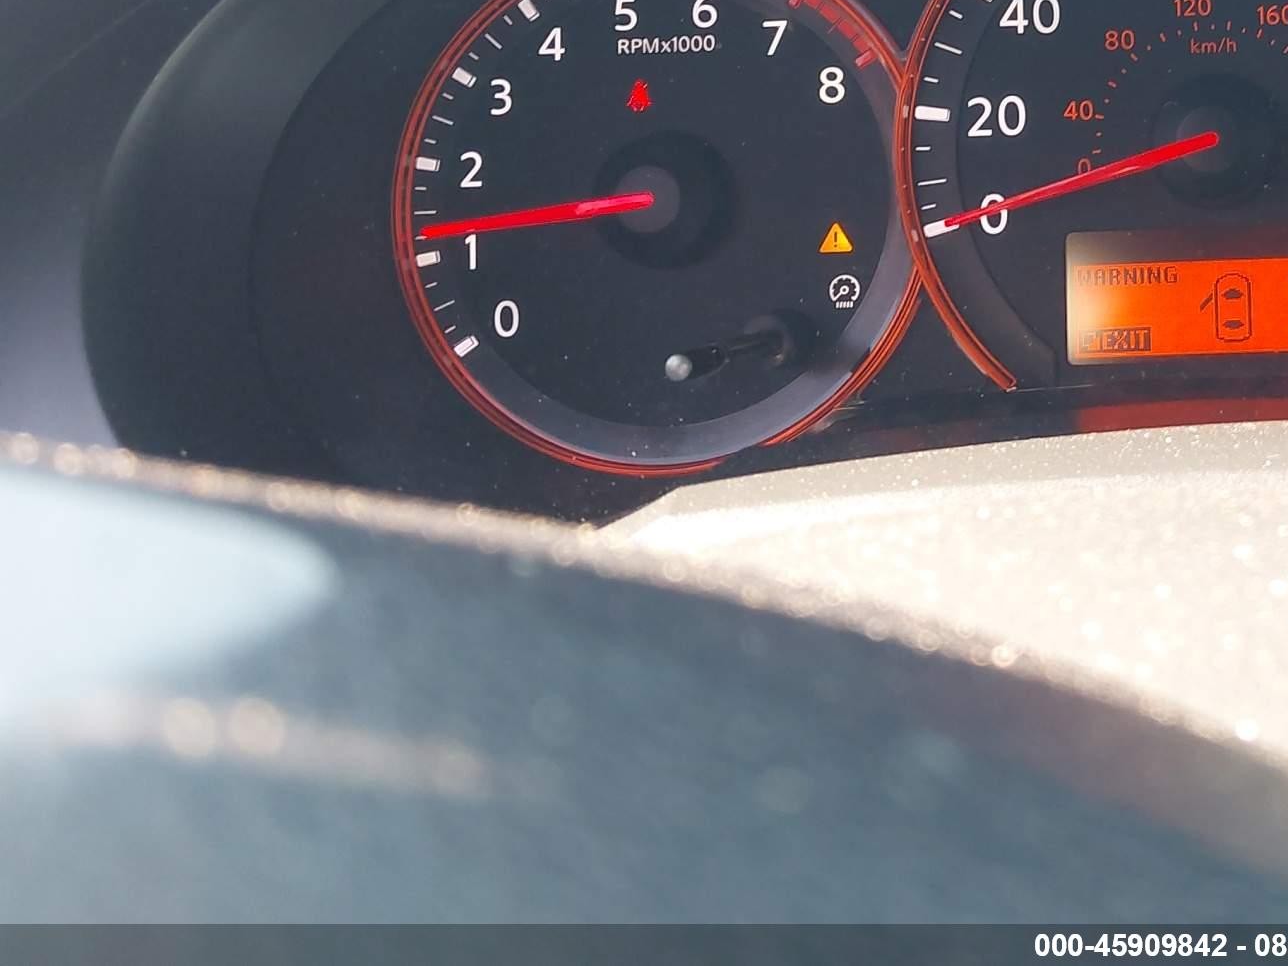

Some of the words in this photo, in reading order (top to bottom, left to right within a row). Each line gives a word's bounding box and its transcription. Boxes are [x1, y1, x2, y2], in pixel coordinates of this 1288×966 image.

[538, 27, 566, 62] 4
[617, 33, 716, 55] RPMx1000
[762, 19, 789, 56] 7
[1105, 29, 1135, 51] 80
[1190, 36, 1238, 56] km/h
[489, 77, 513, 116] 3
[819, 65, 846, 104] 8
[966, 94, 1027, 137] 20
[1063, 99, 1094, 122] 40
[460, 150, 484, 188] 2
[980, 193, 1009, 235] 0
[464, 234, 478, 271] 1
[1078, 264, 1179, 286] WARNING
[493, 299, 520, 338] 0
